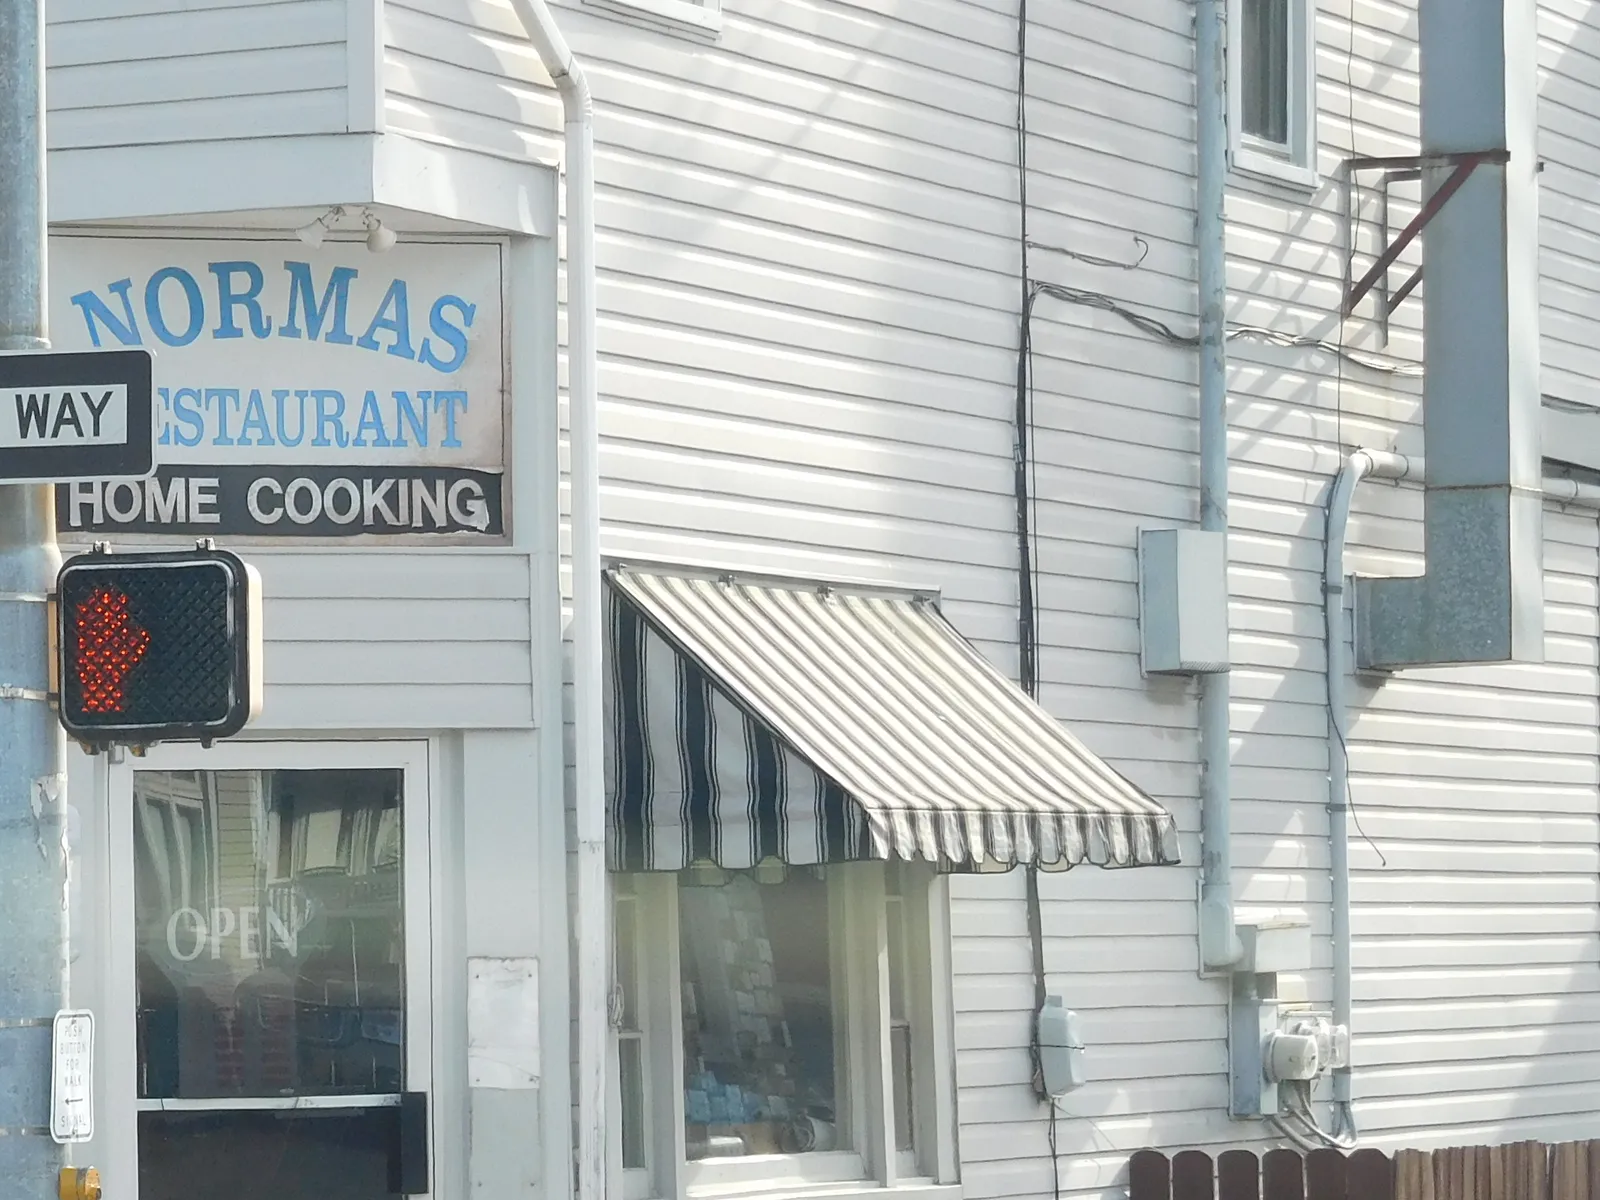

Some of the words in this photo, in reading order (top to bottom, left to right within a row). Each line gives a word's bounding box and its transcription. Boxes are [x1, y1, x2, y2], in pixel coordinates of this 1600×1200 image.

[70, 260, 476, 373] NORMAS
[14, 391, 114, 440] WAY
[157, 386, 468, 448] STAURANT
[68, 477, 221, 527] HOME
[247, 477, 490, 532] COOKING
[166, 906, 298, 961] OPEN
[60, 1041, 86, 1055] BUTTON
[64, 1025, 83, 1037] PUSH
[65, 1058, 80, 1071] FOR
